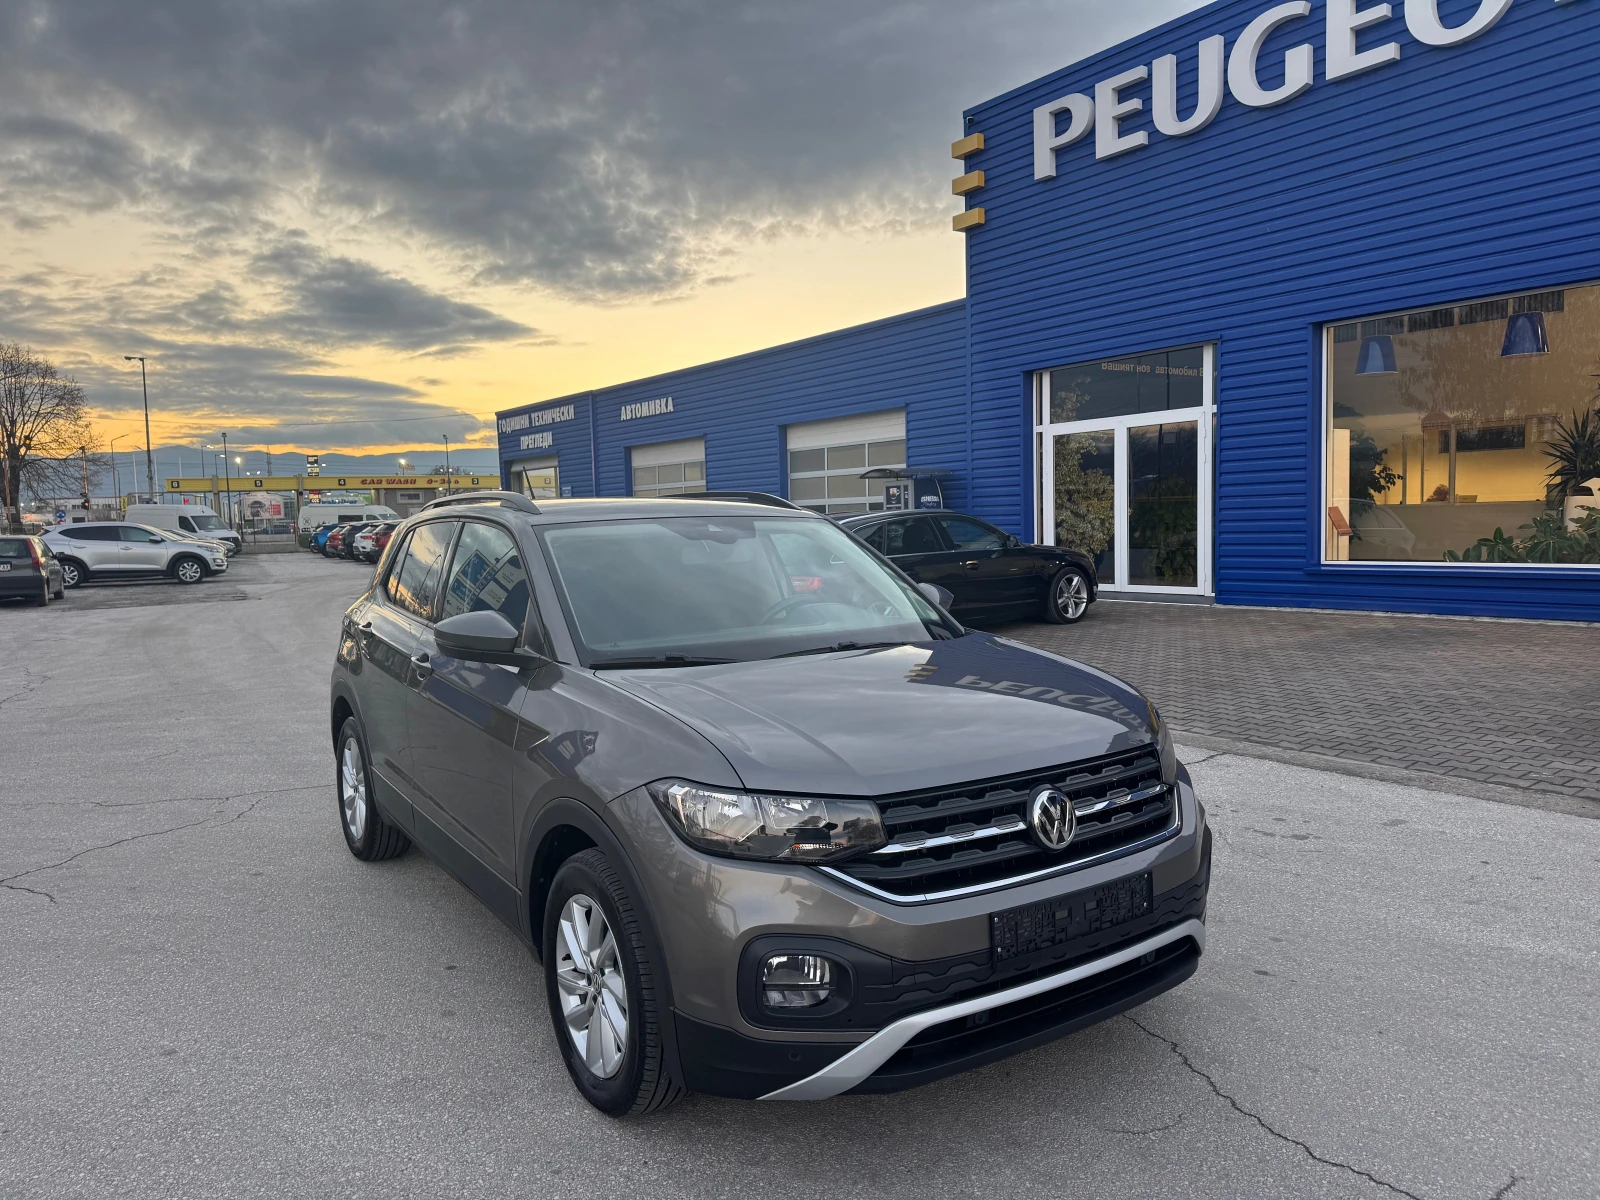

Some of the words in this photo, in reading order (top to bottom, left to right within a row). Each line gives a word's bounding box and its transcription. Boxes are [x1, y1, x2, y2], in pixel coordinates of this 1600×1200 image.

[1155, 366, 1197, 376] автомобил
[498, 414, 530, 434] ГОДИШНИ
[531, 404, 575, 427] ТЕХНИЧЕСКИ
[620, 396, 674, 421] АВТОМИВКА
[520, 431, 553, 450] ПРЕГЛЕДИ
